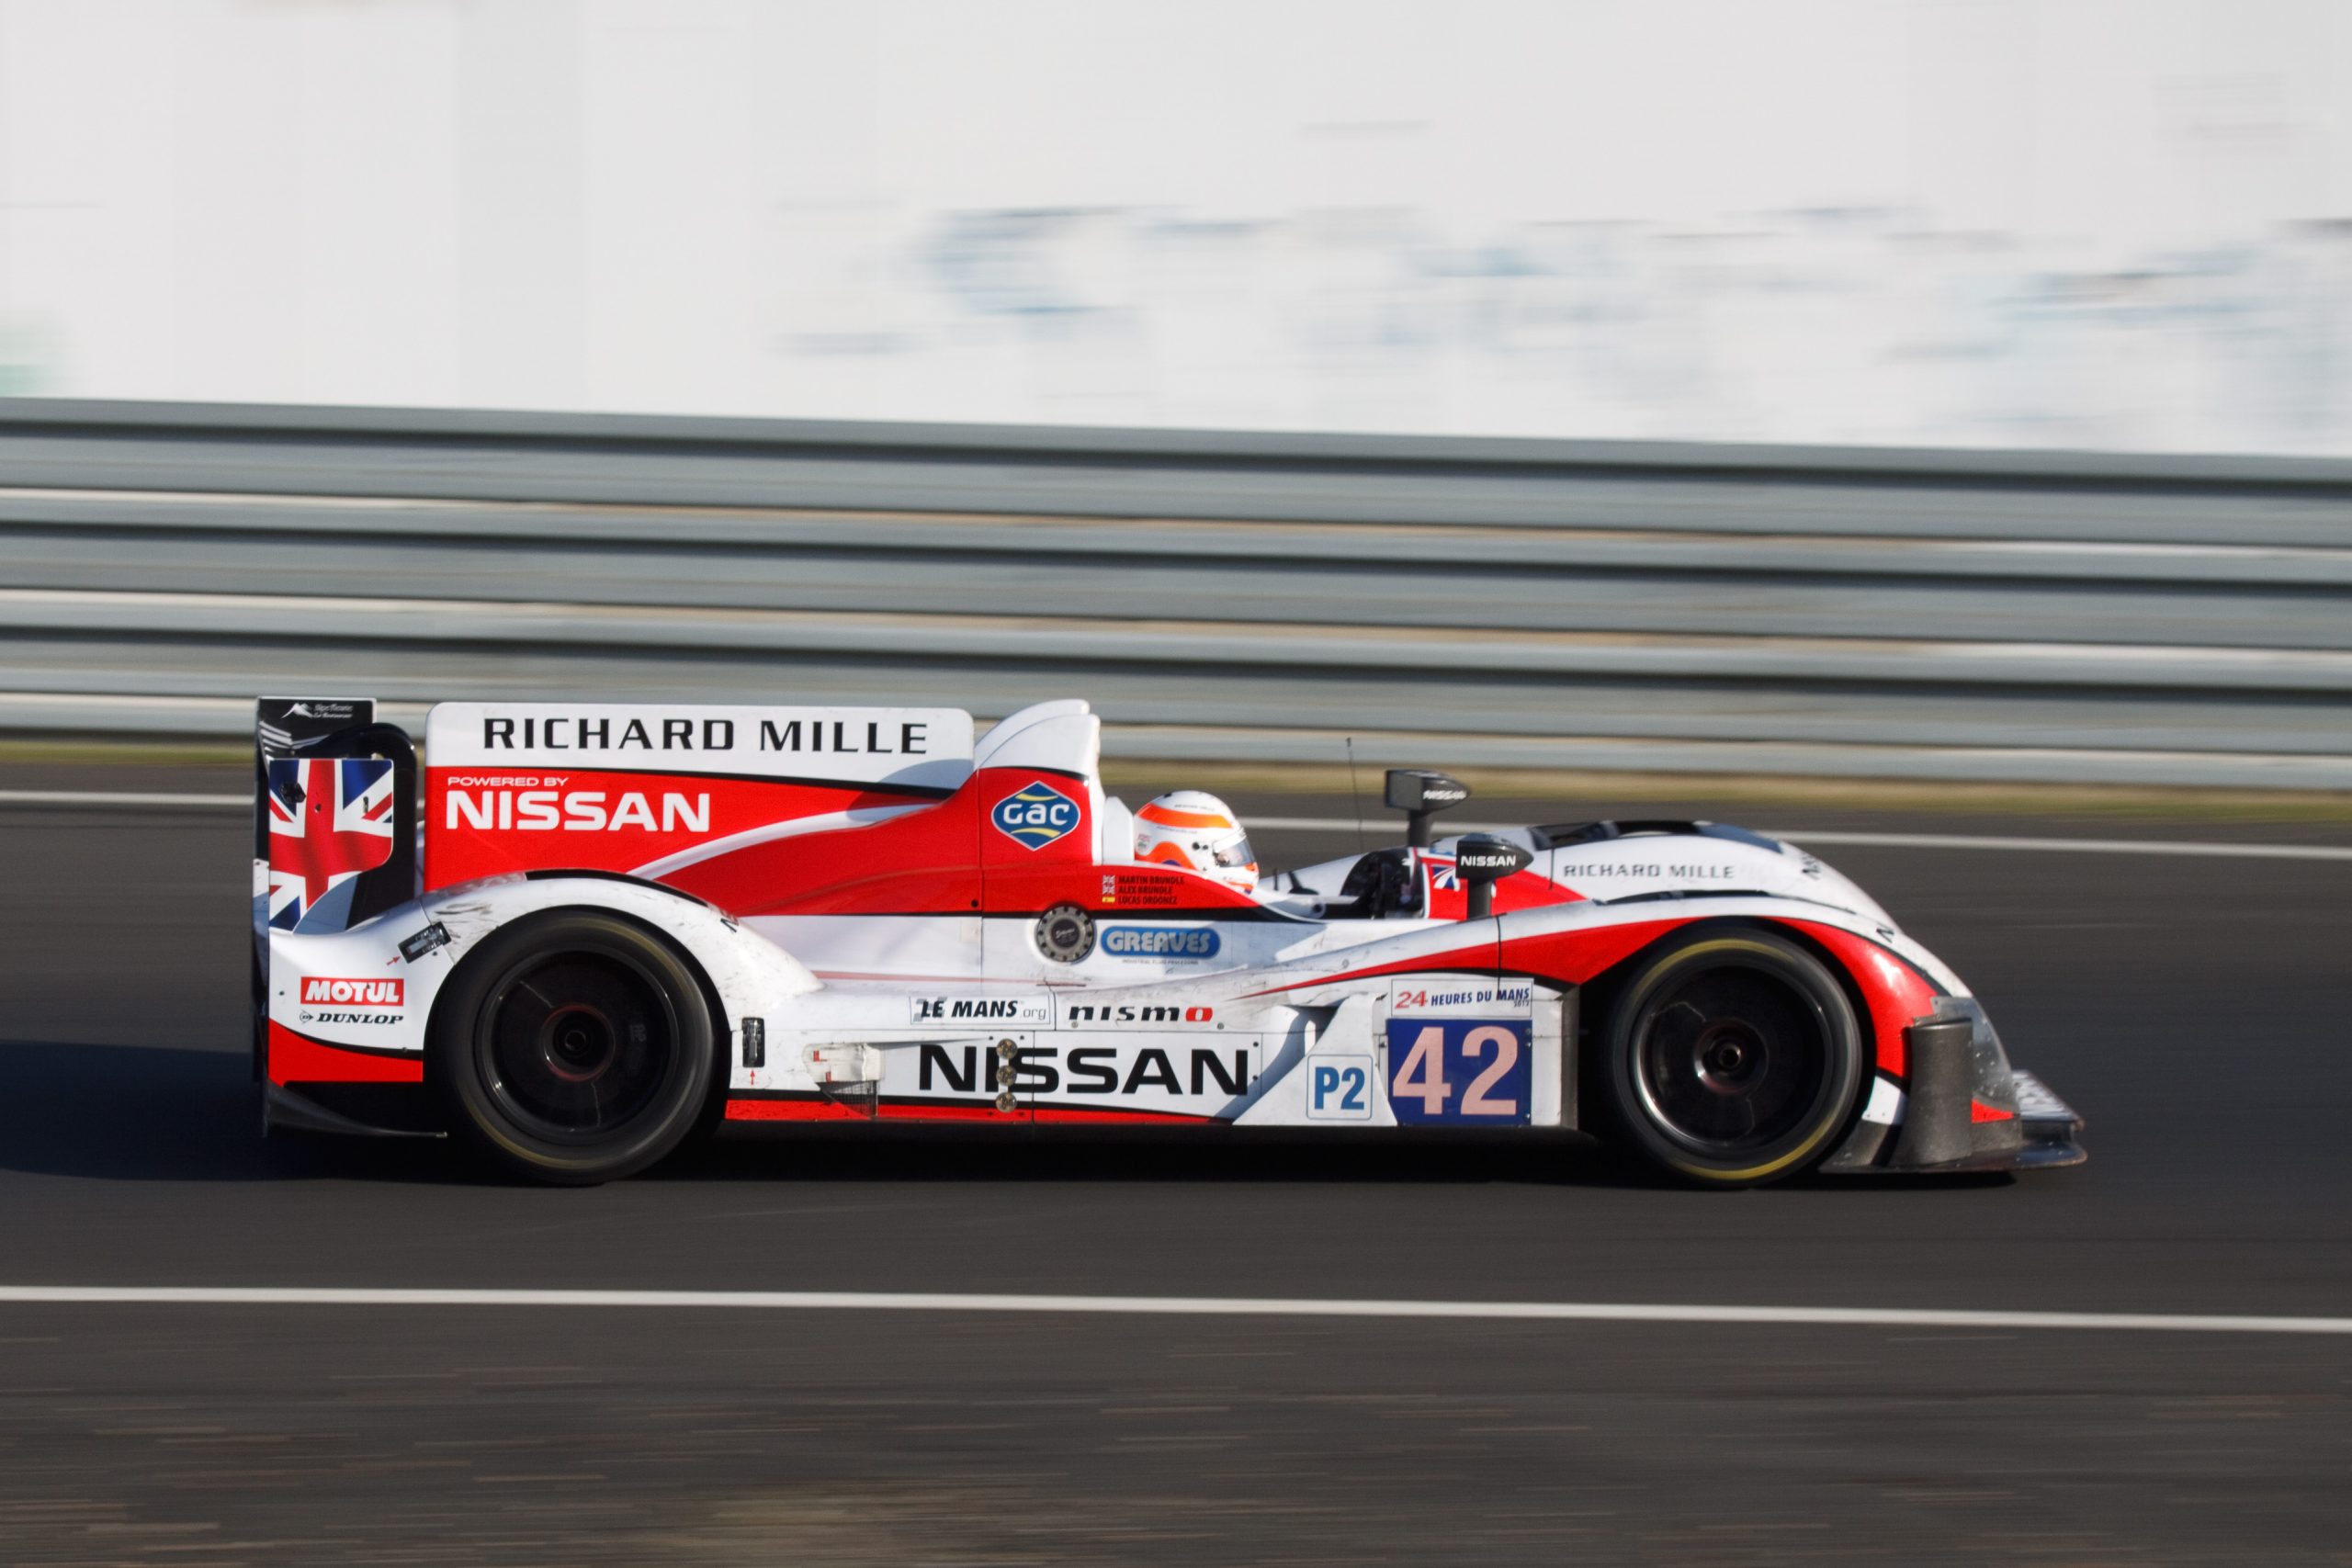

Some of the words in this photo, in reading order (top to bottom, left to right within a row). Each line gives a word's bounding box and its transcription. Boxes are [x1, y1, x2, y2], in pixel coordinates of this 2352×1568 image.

[484, 717, 734, 750] RICHARD
[760, 720, 927, 754] MILLE
[447, 776, 539, 787] POWERED
[543, 776, 569, 787] BY
[446, 790, 710, 832] NISSAN
[1460, 855, 1517, 867] NISSAN
[1118, 875, 1148, 885] MARTIN
[1564, 863, 1660, 878] RICHARD
[1669, 864, 1736, 879] MILLE
[1117, 886, 1136, 895] ALEX
[1117, 896, 1141, 905] LUCAS
[1106, 930, 1211, 954] GREAVES
[304, 980, 400, 1003] MOTUL
[1395, 989, 1429, 1010] 24
[1430, 992, 1473, 1007] HEURES
[1476, 990, 1492, 1002] DU
[1496, 987, 1530, 1001] MANS
[921, 1000, 944, 1018] LE
[1068, 1005, 1214, 1022] nismo
[316, 1012, 404, 1025] DUNLOP
[919, 1044, 1249, 1096] NISSAN
[1393, 1025, 1519, 1116] 42
[1314, 1066, 1366, 1111] P2
